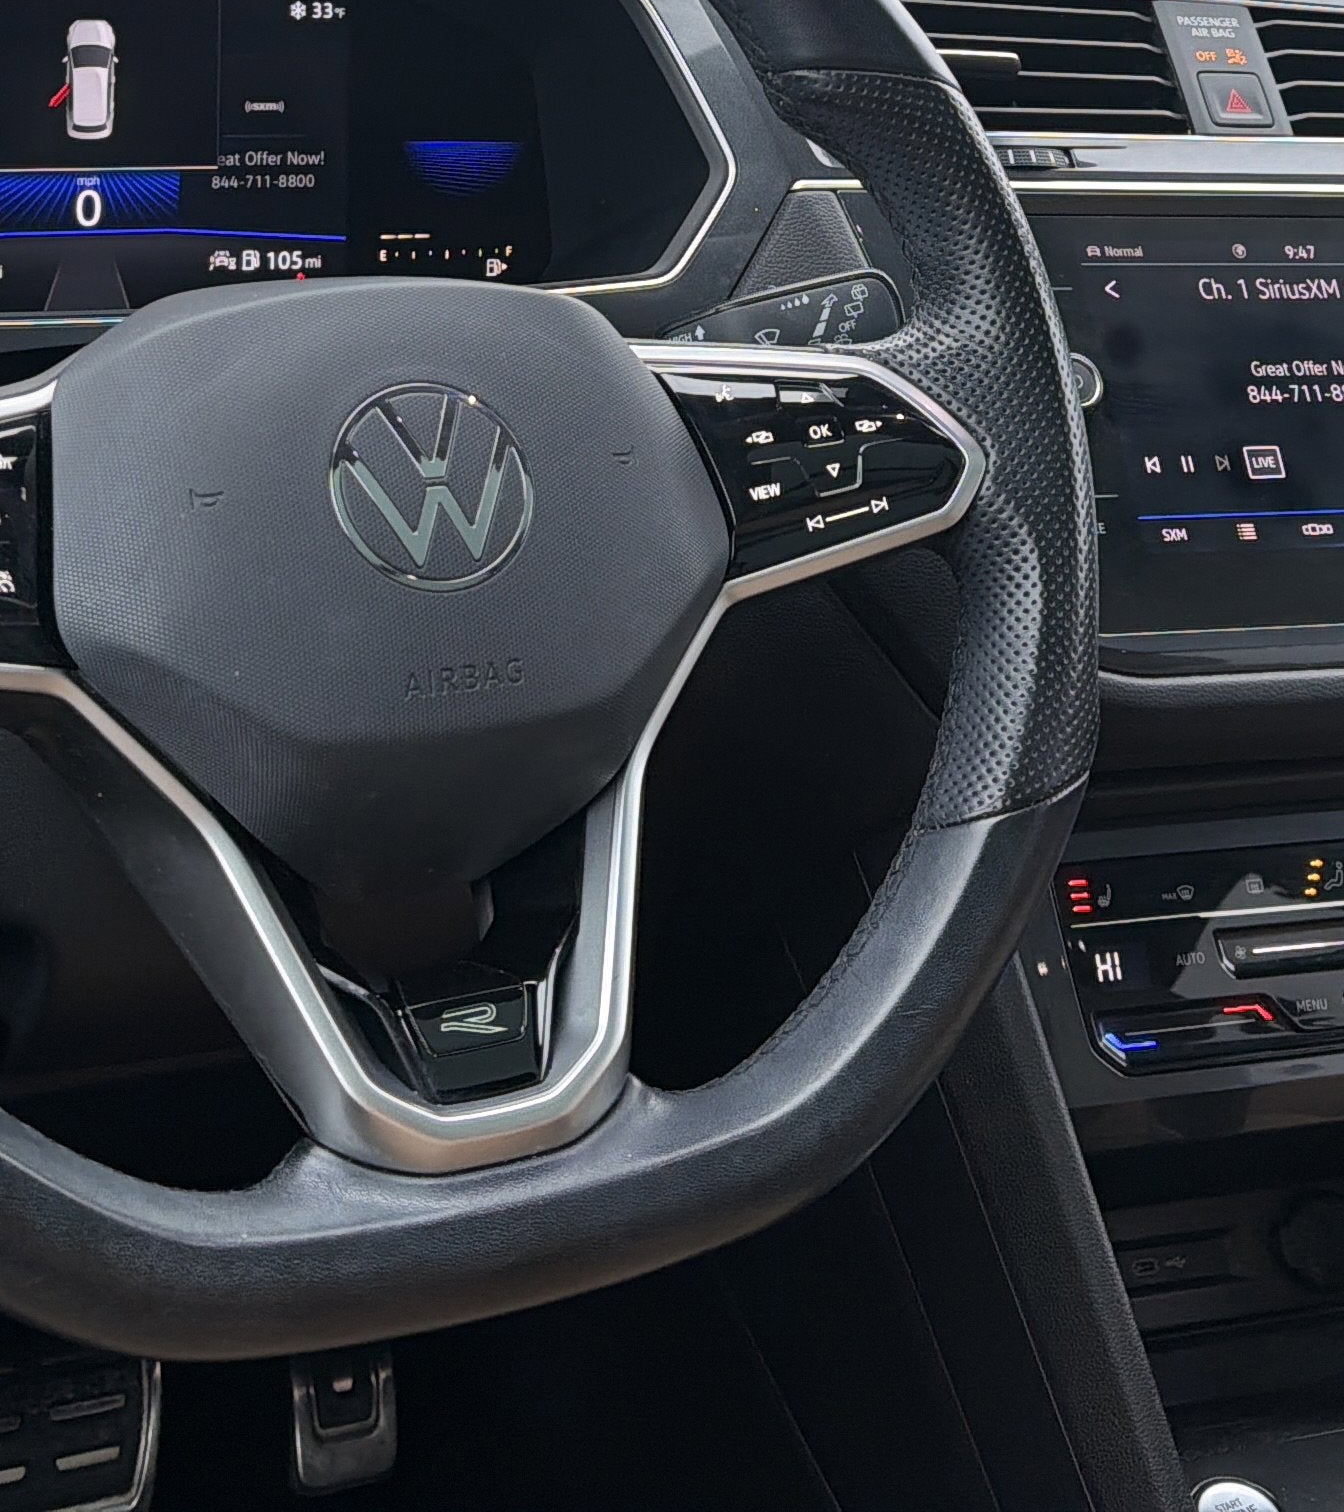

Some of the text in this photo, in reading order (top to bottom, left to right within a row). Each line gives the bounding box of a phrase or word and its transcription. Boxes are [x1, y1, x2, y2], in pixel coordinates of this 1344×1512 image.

[1176, 15, 1240, 28] PASSENGER
[1191, 27, 1236, 38] AIR BAG
[1196, 50, 1217, 62] OFF
[218, 151, 325, 167] eat Offer Now!
[76, 176, 101, 186] mph
[211, 175, 316, 190] 844-711-8800
[75, 190, 102, 227] 0
[379, 249, 387, 262] E
[506, 245, 513, 256] F
[1104, 245, 1144, 257] Normal
[1284, 245, 1315, 260] 9:47
[266, 251, 322, 270] 105 mi
[1198, 278, 1233, 300] Ch.
[1236, 279, 1249, 299] 1
[1255, 278, 1341, 300] SiriusXM
[838, 318, 857, 333] OFF
[1250, 361, 1289, 377] Great
[1291, 360, 1328, 376] Offer
[808, 424, 832, 439] OK
[1252, 455, 1277, 469] LIVE
[749, 483, 782, 501] VIEW
[1161, 527, 1189, 542] SXM
[404, 657, 525, 701] AIRBAG
[1176, 951, 1206, 966] AUTO
[1096, 951, 1124, 983] HI
[1295, 998, 1328, 1014] MENU
